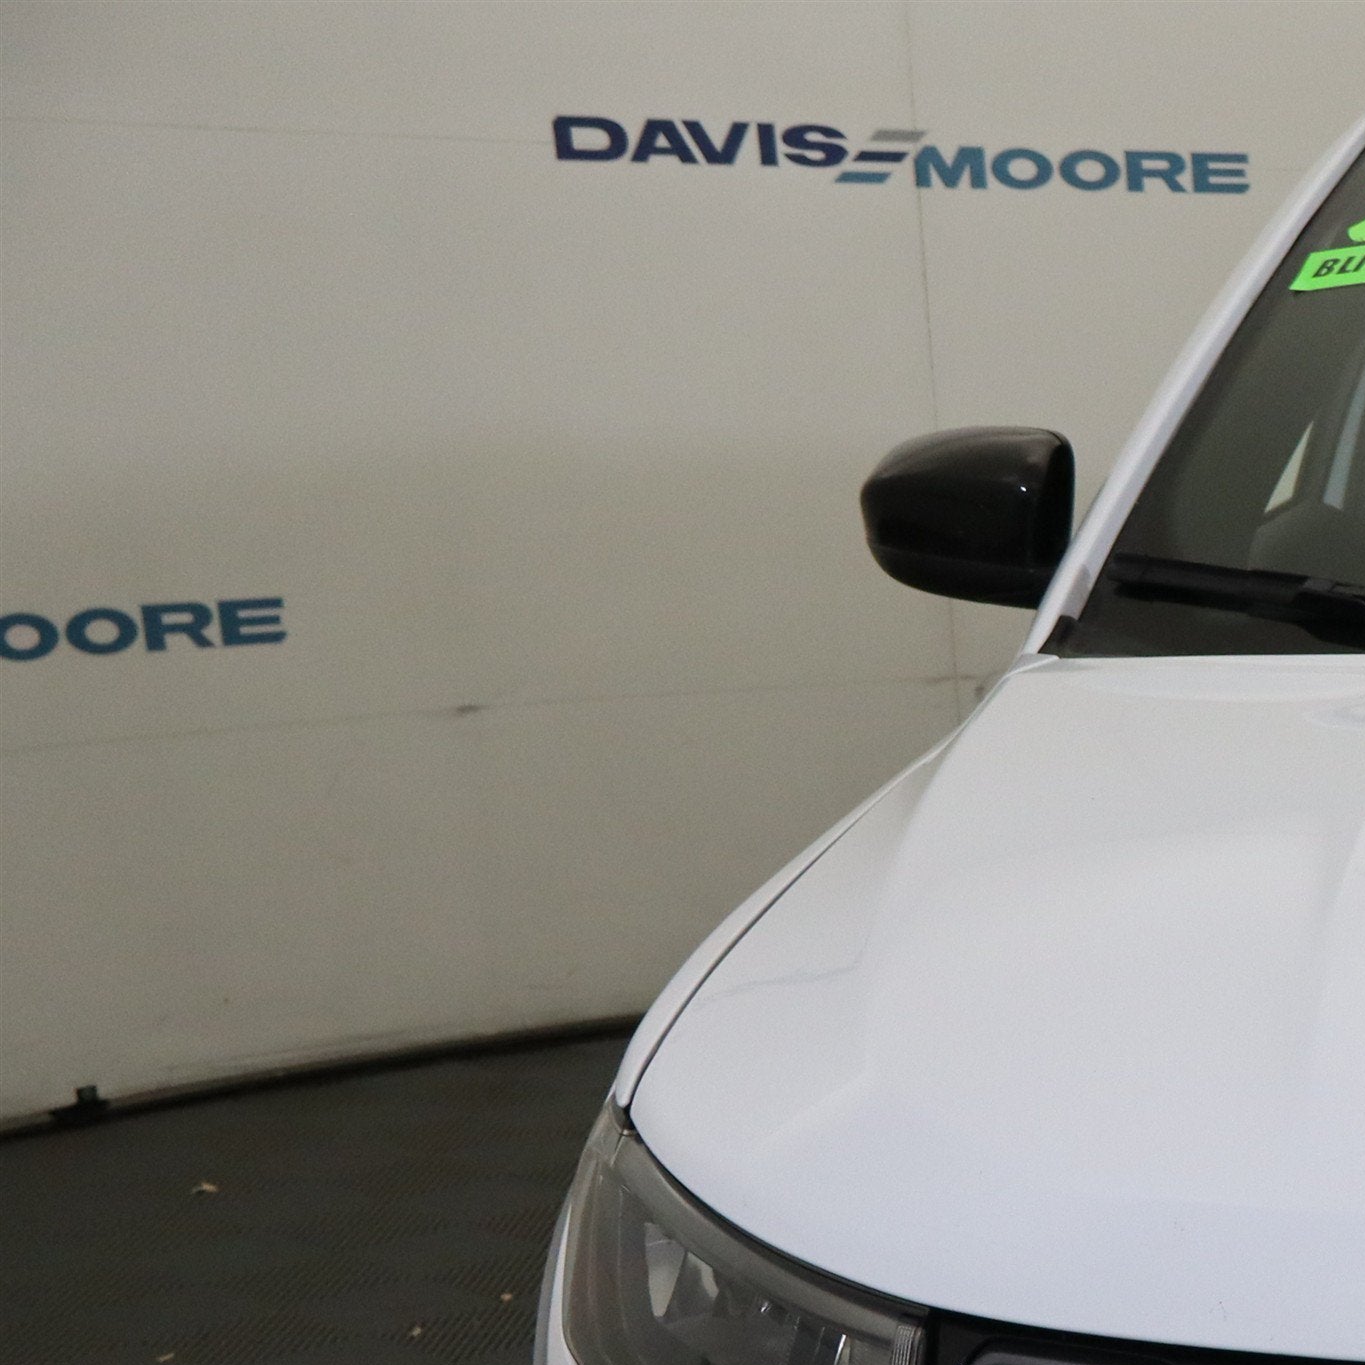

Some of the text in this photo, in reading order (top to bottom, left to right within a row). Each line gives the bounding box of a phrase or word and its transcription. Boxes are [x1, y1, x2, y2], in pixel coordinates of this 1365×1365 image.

[551, 115, 1250, 194] DAVIS MOORE
[0, 596, 288, 662] OORE
